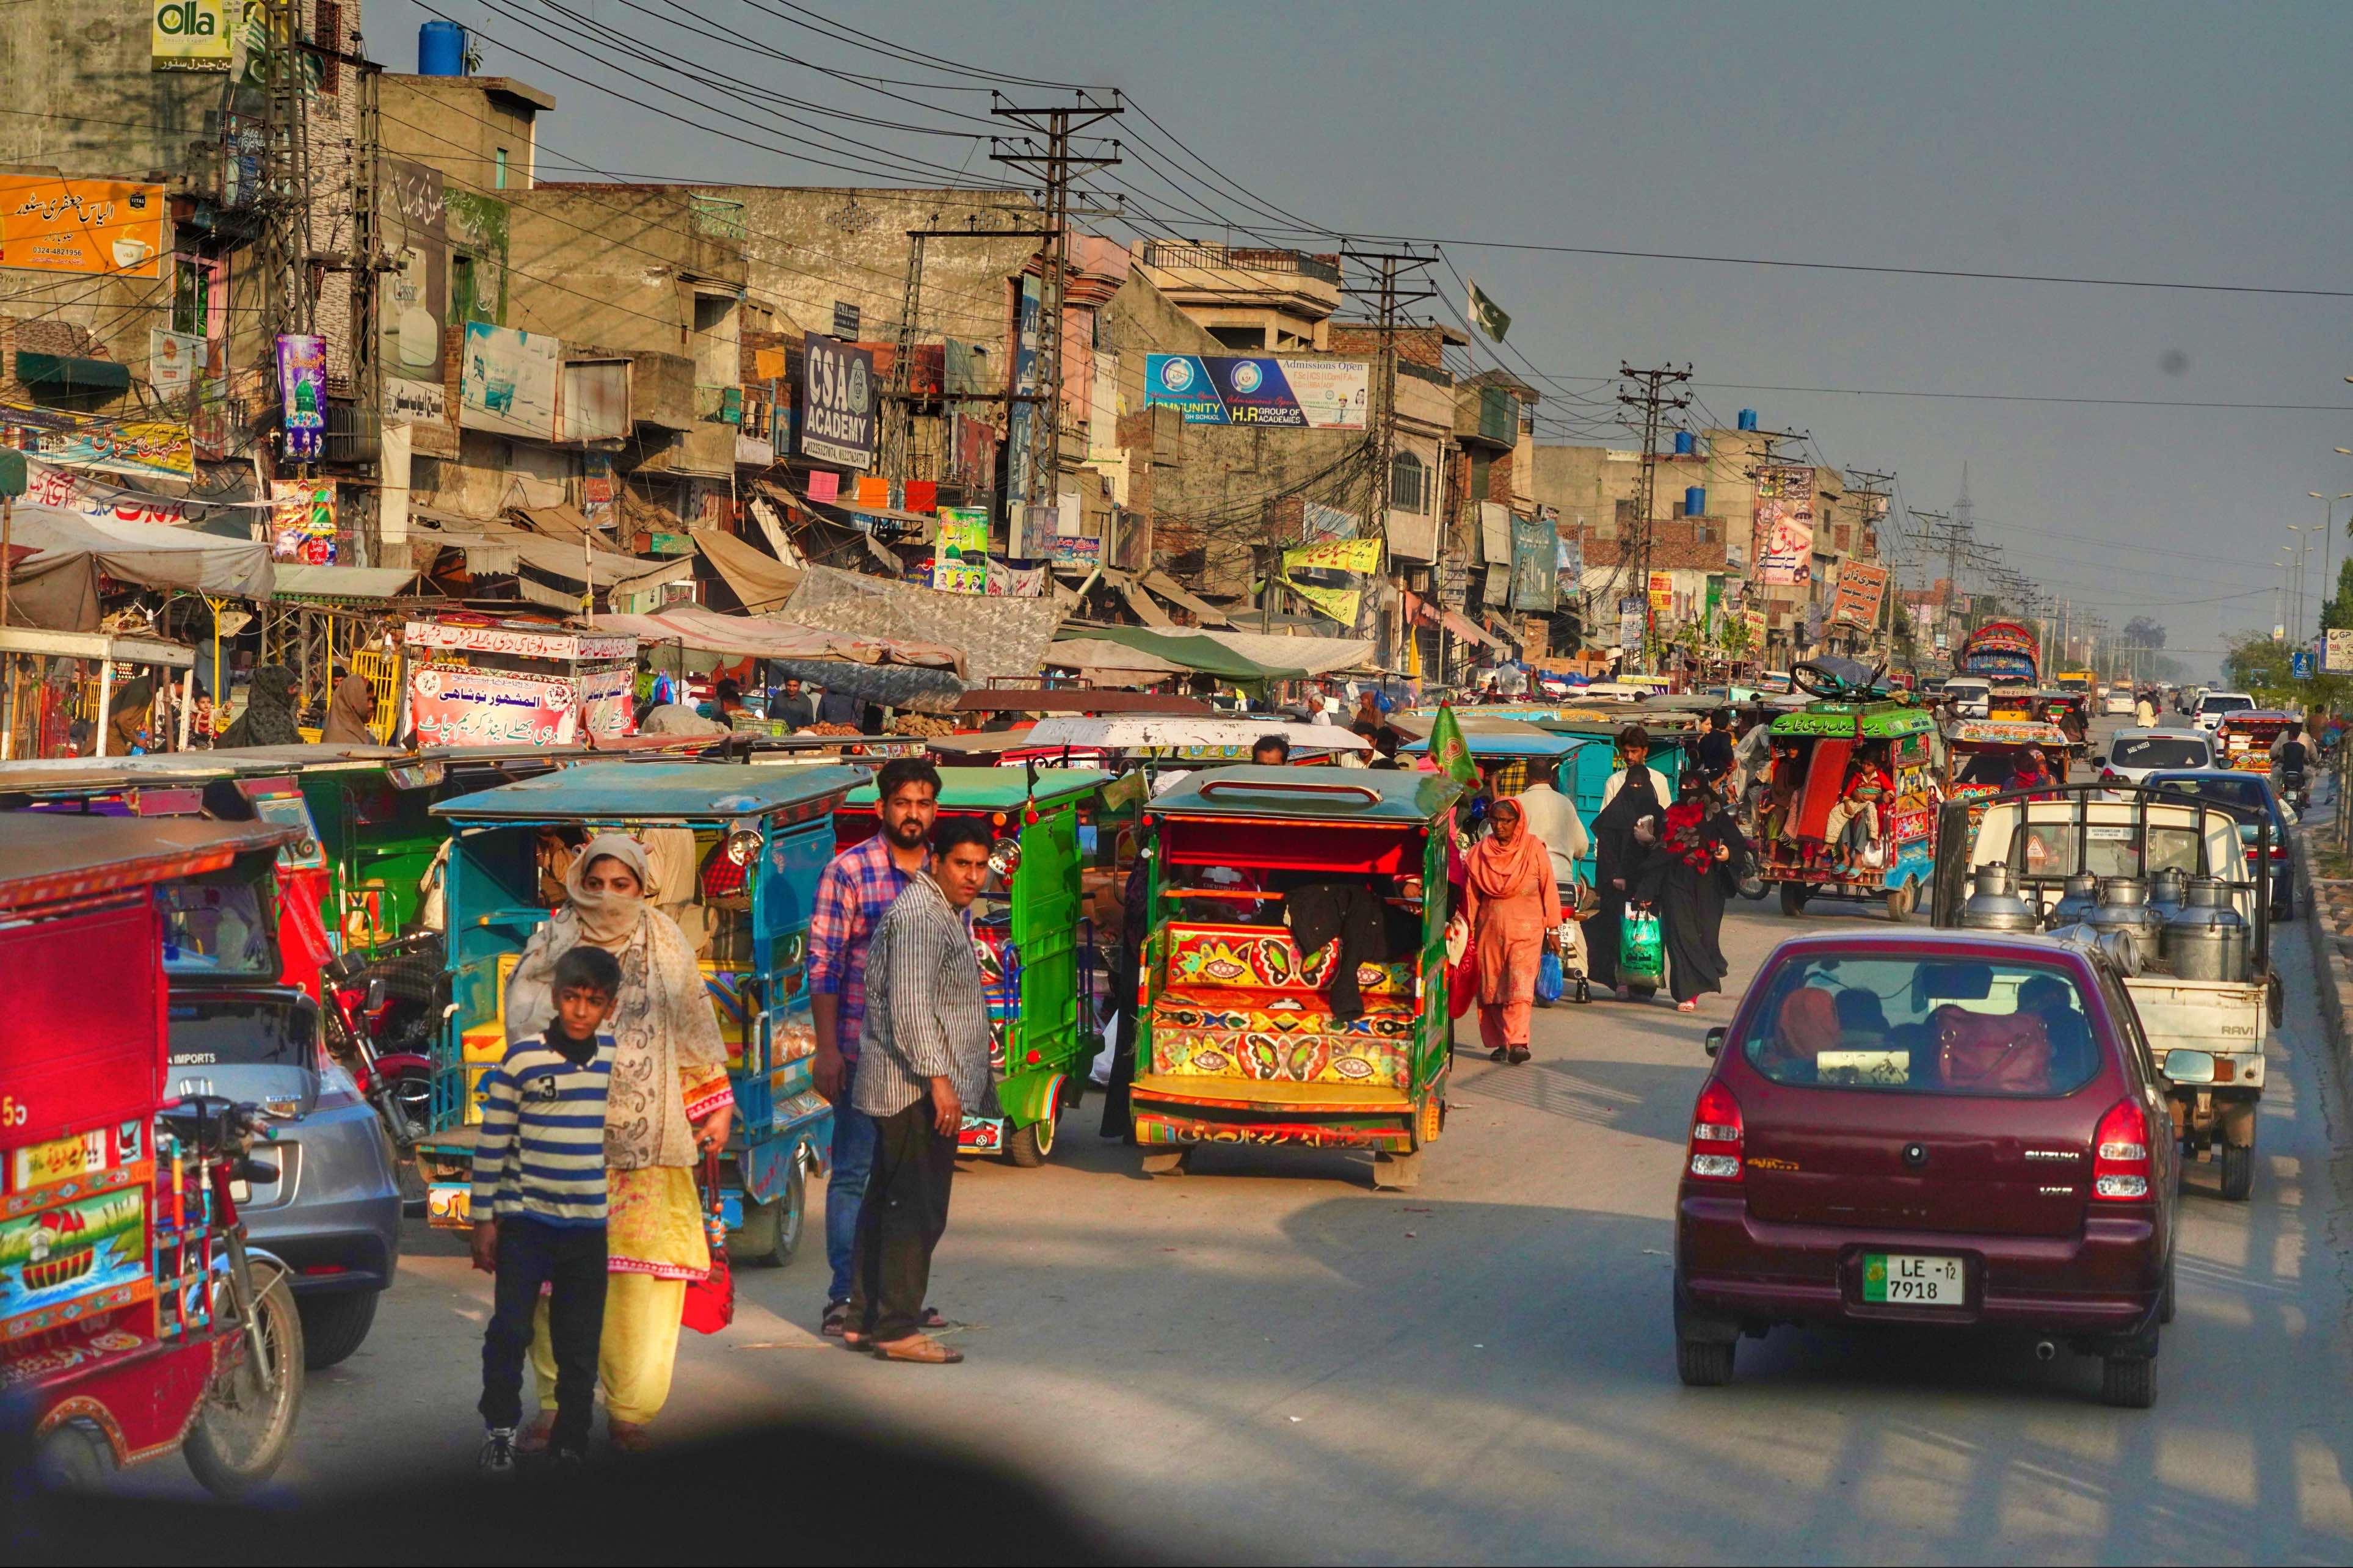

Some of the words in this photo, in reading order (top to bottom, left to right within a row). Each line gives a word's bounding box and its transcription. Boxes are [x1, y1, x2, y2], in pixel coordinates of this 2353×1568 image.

[157, 1, 215, 35] Olla
[161, 56, 187, 70] سٹور
[187, 58, 216, 70] جنرل
[15, 192, 44, 215] سٹور
[42, 195, 82, 221] جعفری
[78, 201, 114, 225] الیاس
[33, 247, 82, 256] 0324-4821956
[393, 278, 418, 302] Classic
[1283, 360, 1336, 370] Admissions
[1338, 362, 1363, 372] Open
[809, 345, 848, 412] CSA
[1226, 396, 1271, 405] Admissions
[1232, 406, 1258, 422] H.R
[1259, 407, 1287, 416] GROUP
[807, 405, 867, 444] ACADEMY
[1769, 526, 1809, 555] صادق
[440, 688, 487, 704] نوشاہی
[489, 692, 540, 708] المشہور
[418, 713, 454, 742] چاٹ
[456, 711, 490, 740] کریم
[484, 717, 507, 742] اینڈ
[506, 717, 534, 741] بھلے
[533, 725, 558, 746] دہی
[2222, 1025, 2254, 1035] RAVI
[173, 1053, 216, 1064] IMPORTS
[539, 1075, 559, 1101] 3
[2024, 1150, 2079, 1162] SUZUKI
[1901, 1259, 1926, 1277] LE
[1890, 1280, 1938, 1299] 7918
